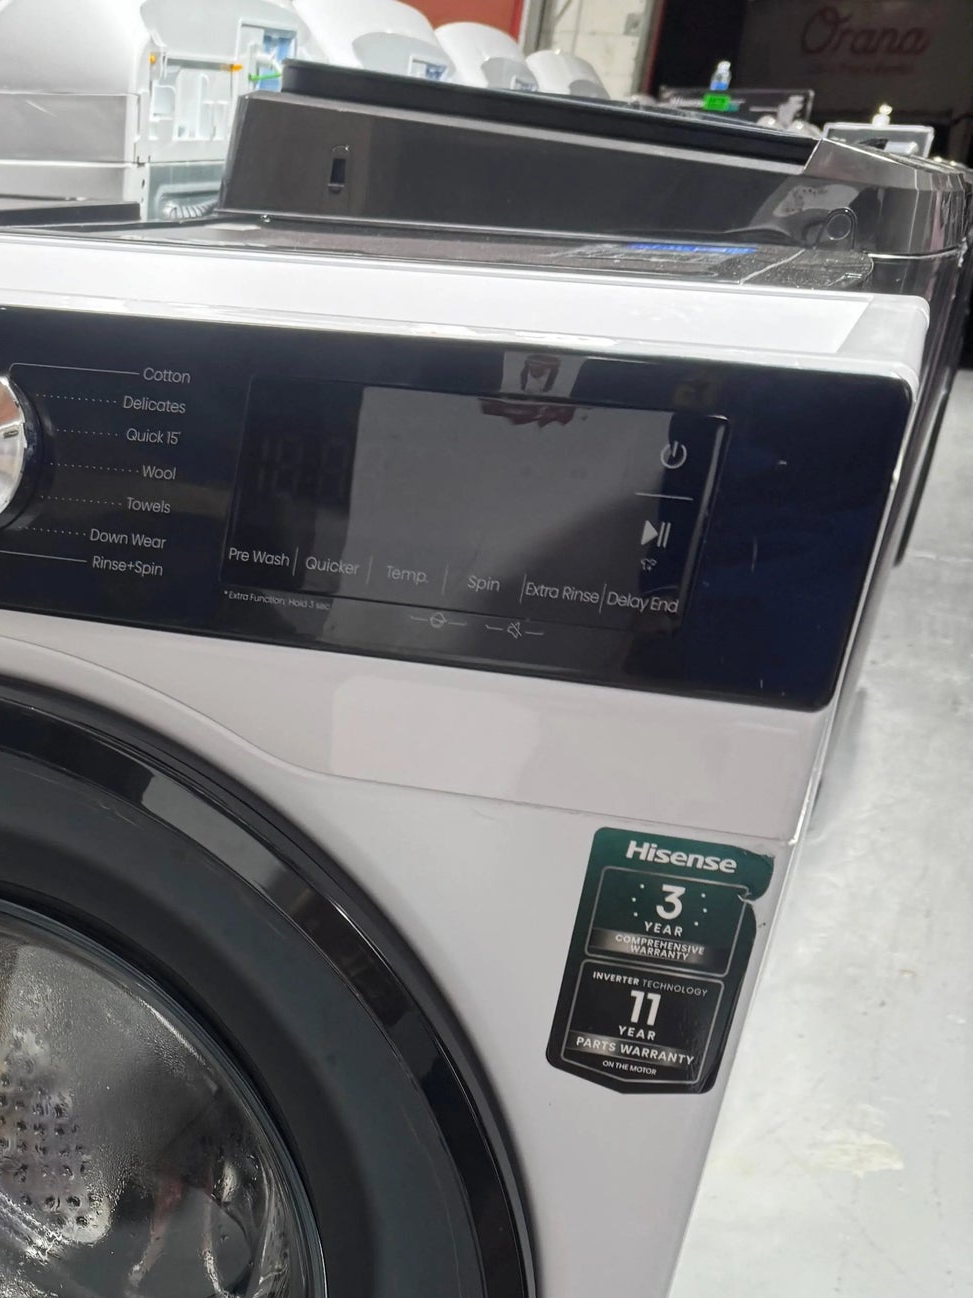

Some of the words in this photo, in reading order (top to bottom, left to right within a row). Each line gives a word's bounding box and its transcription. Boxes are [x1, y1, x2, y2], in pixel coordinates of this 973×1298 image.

[142, 367, 191, 384] Cotton
[123, 395, 186, 414] Delicates
[126, 428, 164, 444] Quick
[142, 465, 176, 480] Wool
[126, 497, 171, 514] Towels
[89, 528, 128, 545] Down
[131, 533, 166, 549] Wear
[92, 556, 163, 577] Rinse+Spin
[229, 547, 250, 562] Pre
[252, 550, 290, 567] Wash
[305, 556, 360, 576] Quicker
[386, 565, 429, 585] Temp.
[467, 575, 500, 593] Spin
[525, 582, 559, 599] Extra
[563, 585, 600, 604] Rinse
[606, 591, 649, 613] Delay
[650, 596, 679, 613] End
[625, 840, 737, 874] Hisense
[655, 884, 686, 920] 3
[644, 921, 683, 937] YEAR
[615, 934, 705, 955] COMPREHENSIVE
[629, 945, 689, 961] WARRANTY
[593, 971, 640, 986] INVERTER
[642, 979, 708, 997] TECHNOLOGY
[630, 989, 661, 1026] 11
[618, 1025, 656, 1040] YEAR
[576, 1036, 617, 1052] PARTS
[620, 1044, 695, 1065] WARRANTY
[602, 1059, 614, 1069] ON
[615, 1061, 629, 1071] THE
[629, 1064, 657, 1076] MOTOR
